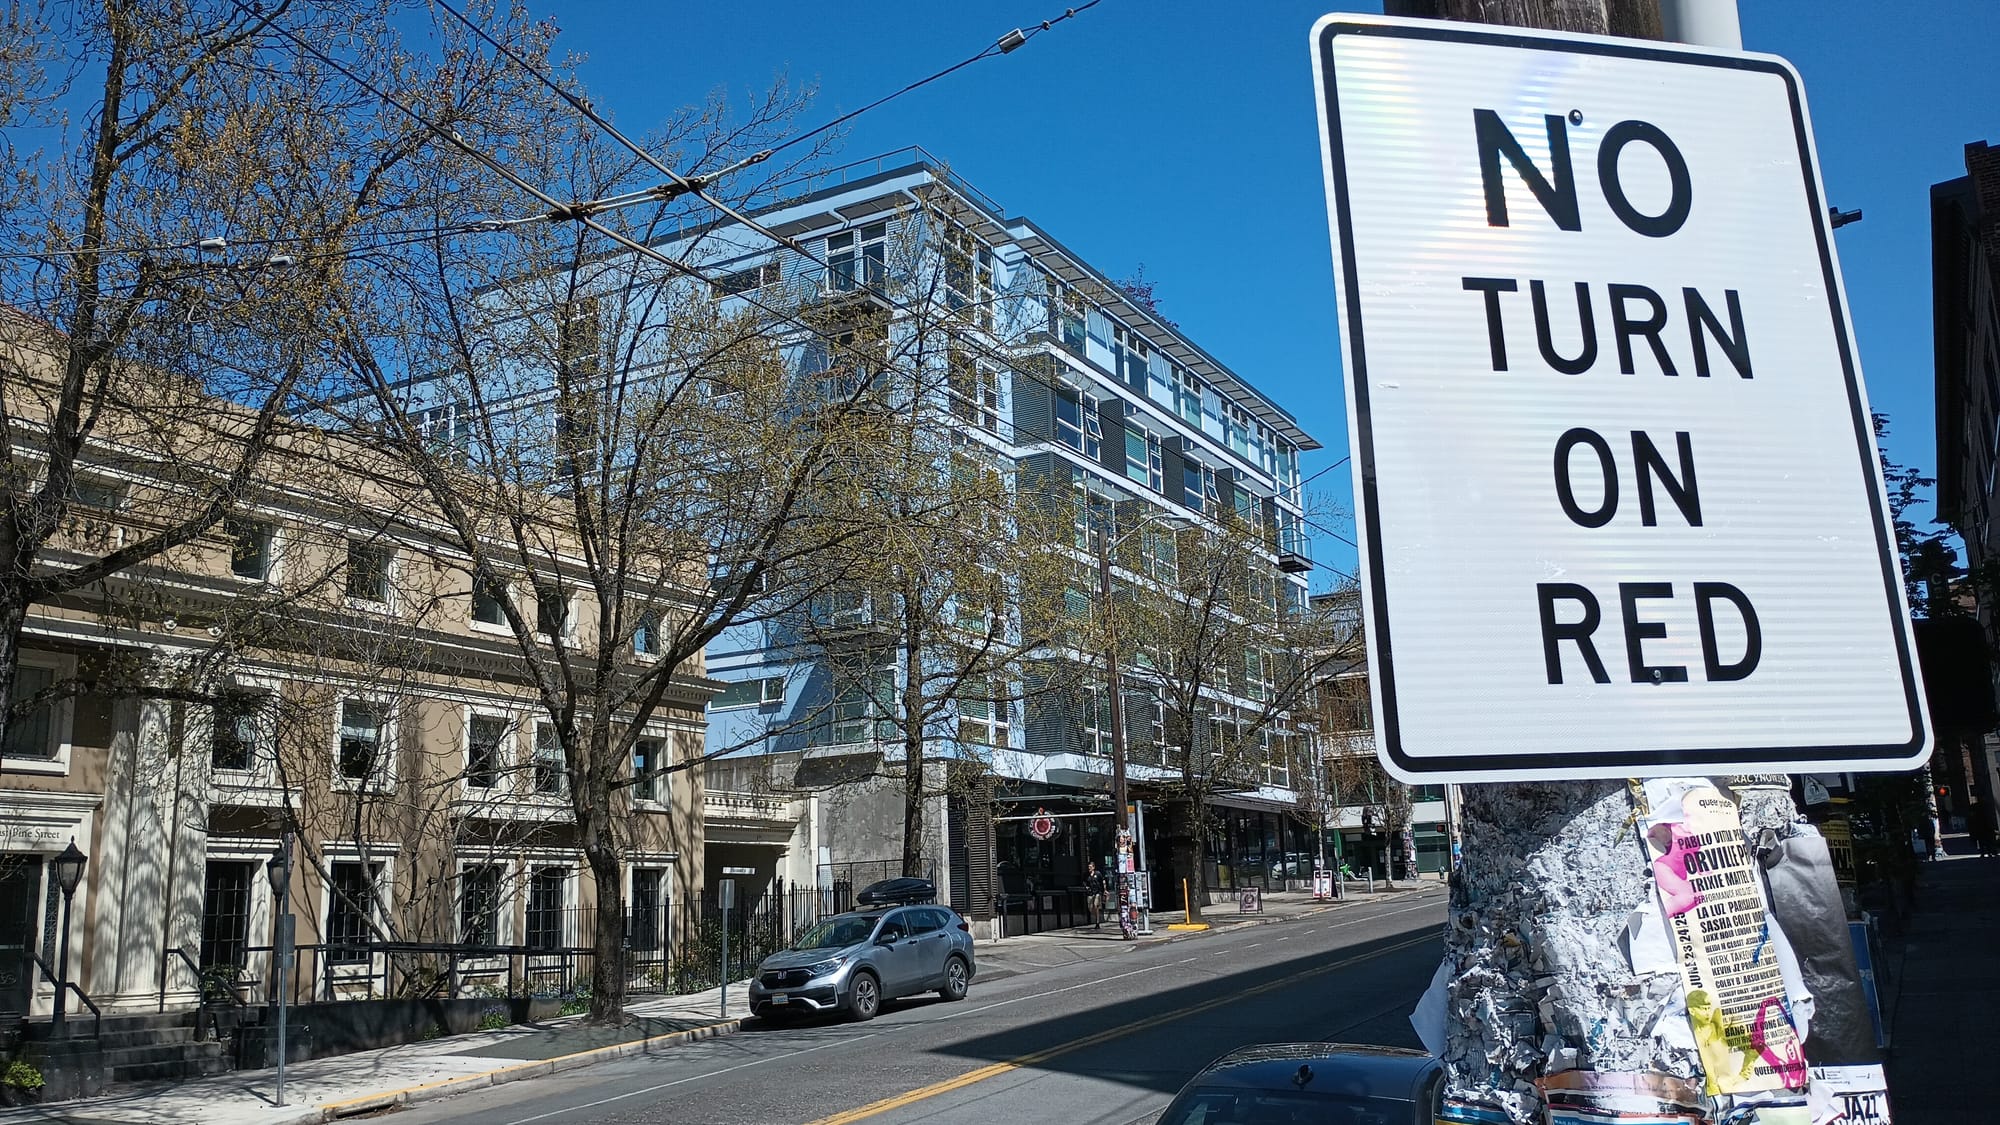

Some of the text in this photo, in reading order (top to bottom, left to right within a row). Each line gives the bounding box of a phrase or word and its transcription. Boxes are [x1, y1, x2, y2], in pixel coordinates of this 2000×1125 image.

[1474, 109, 1692, 237] NO
[1462, 277, 1753, 379] TURN
[1554, 428, 1703, 528] ON
[1537, 582, 1761, 685] RED
[12, 828, 32, 838] Pine
[34, 828, 60, 839] Street
[1678, 833, 1713, 850] PABLLO
[1684, 845, 1739, 875] ORVILLE
[1689, 873, 1725, 893] TRIXIE
[1725, 870, 1749, 887] MATTEL
[1696, 907, 1709, 919] LA
[1710, 903, 1726, 916] LUZ
[1700, 916, 1732, 933] SASHA
[1708, 954, 1729, 966] WERK
[1711, 965, 1731, 976] KEVIN
[1725, 1026, 1745, 1037] BANG
[1746, 1023, 1760, 1034] THE
[1841, 1096, 1879, 1120] JAZZ
